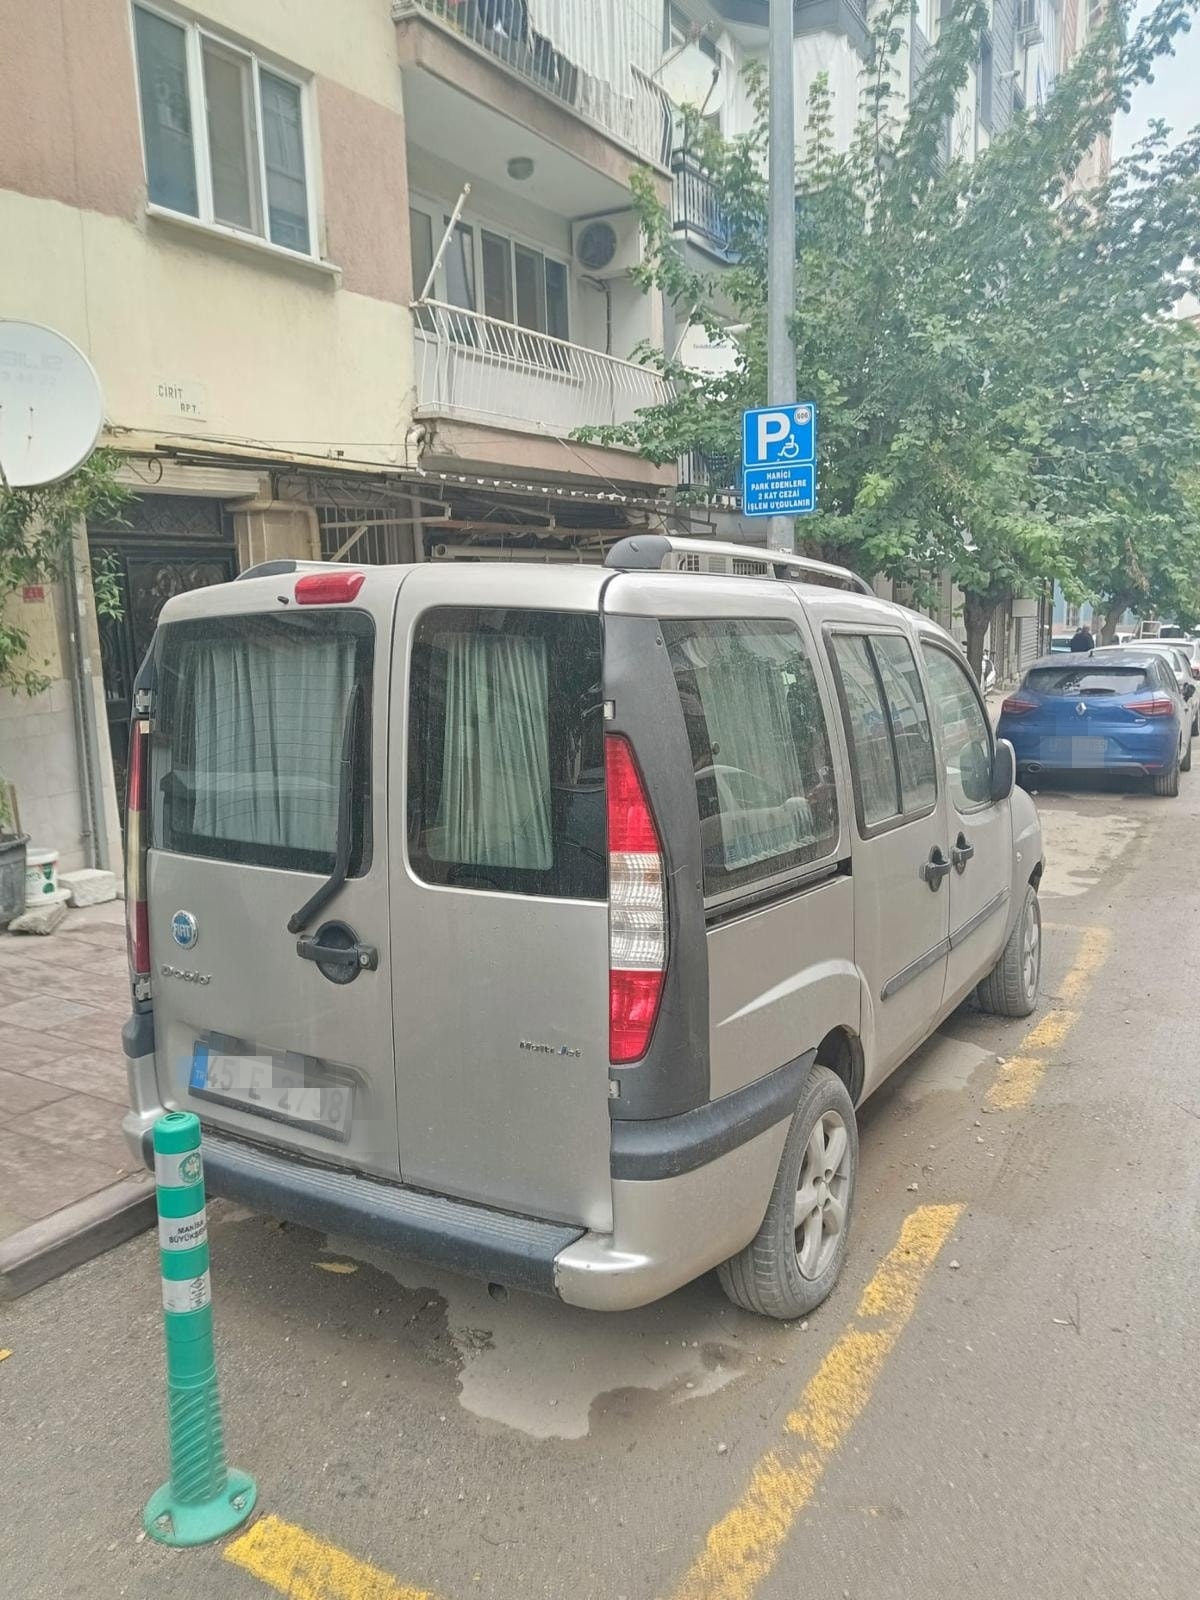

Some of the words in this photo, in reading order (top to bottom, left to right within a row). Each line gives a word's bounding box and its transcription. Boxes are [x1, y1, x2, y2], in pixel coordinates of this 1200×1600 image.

[758, 412, 790, 460] P
[767, 469, 791, 480] HARİCİ
[751, 482, 770, 491] PARK
[770, 479, 807, 489] EDENLERE
[758, 493, 763, 501] 2
[764, 491, 778, 500] KAT
[778, 488, 800, 499] CEZAİ
